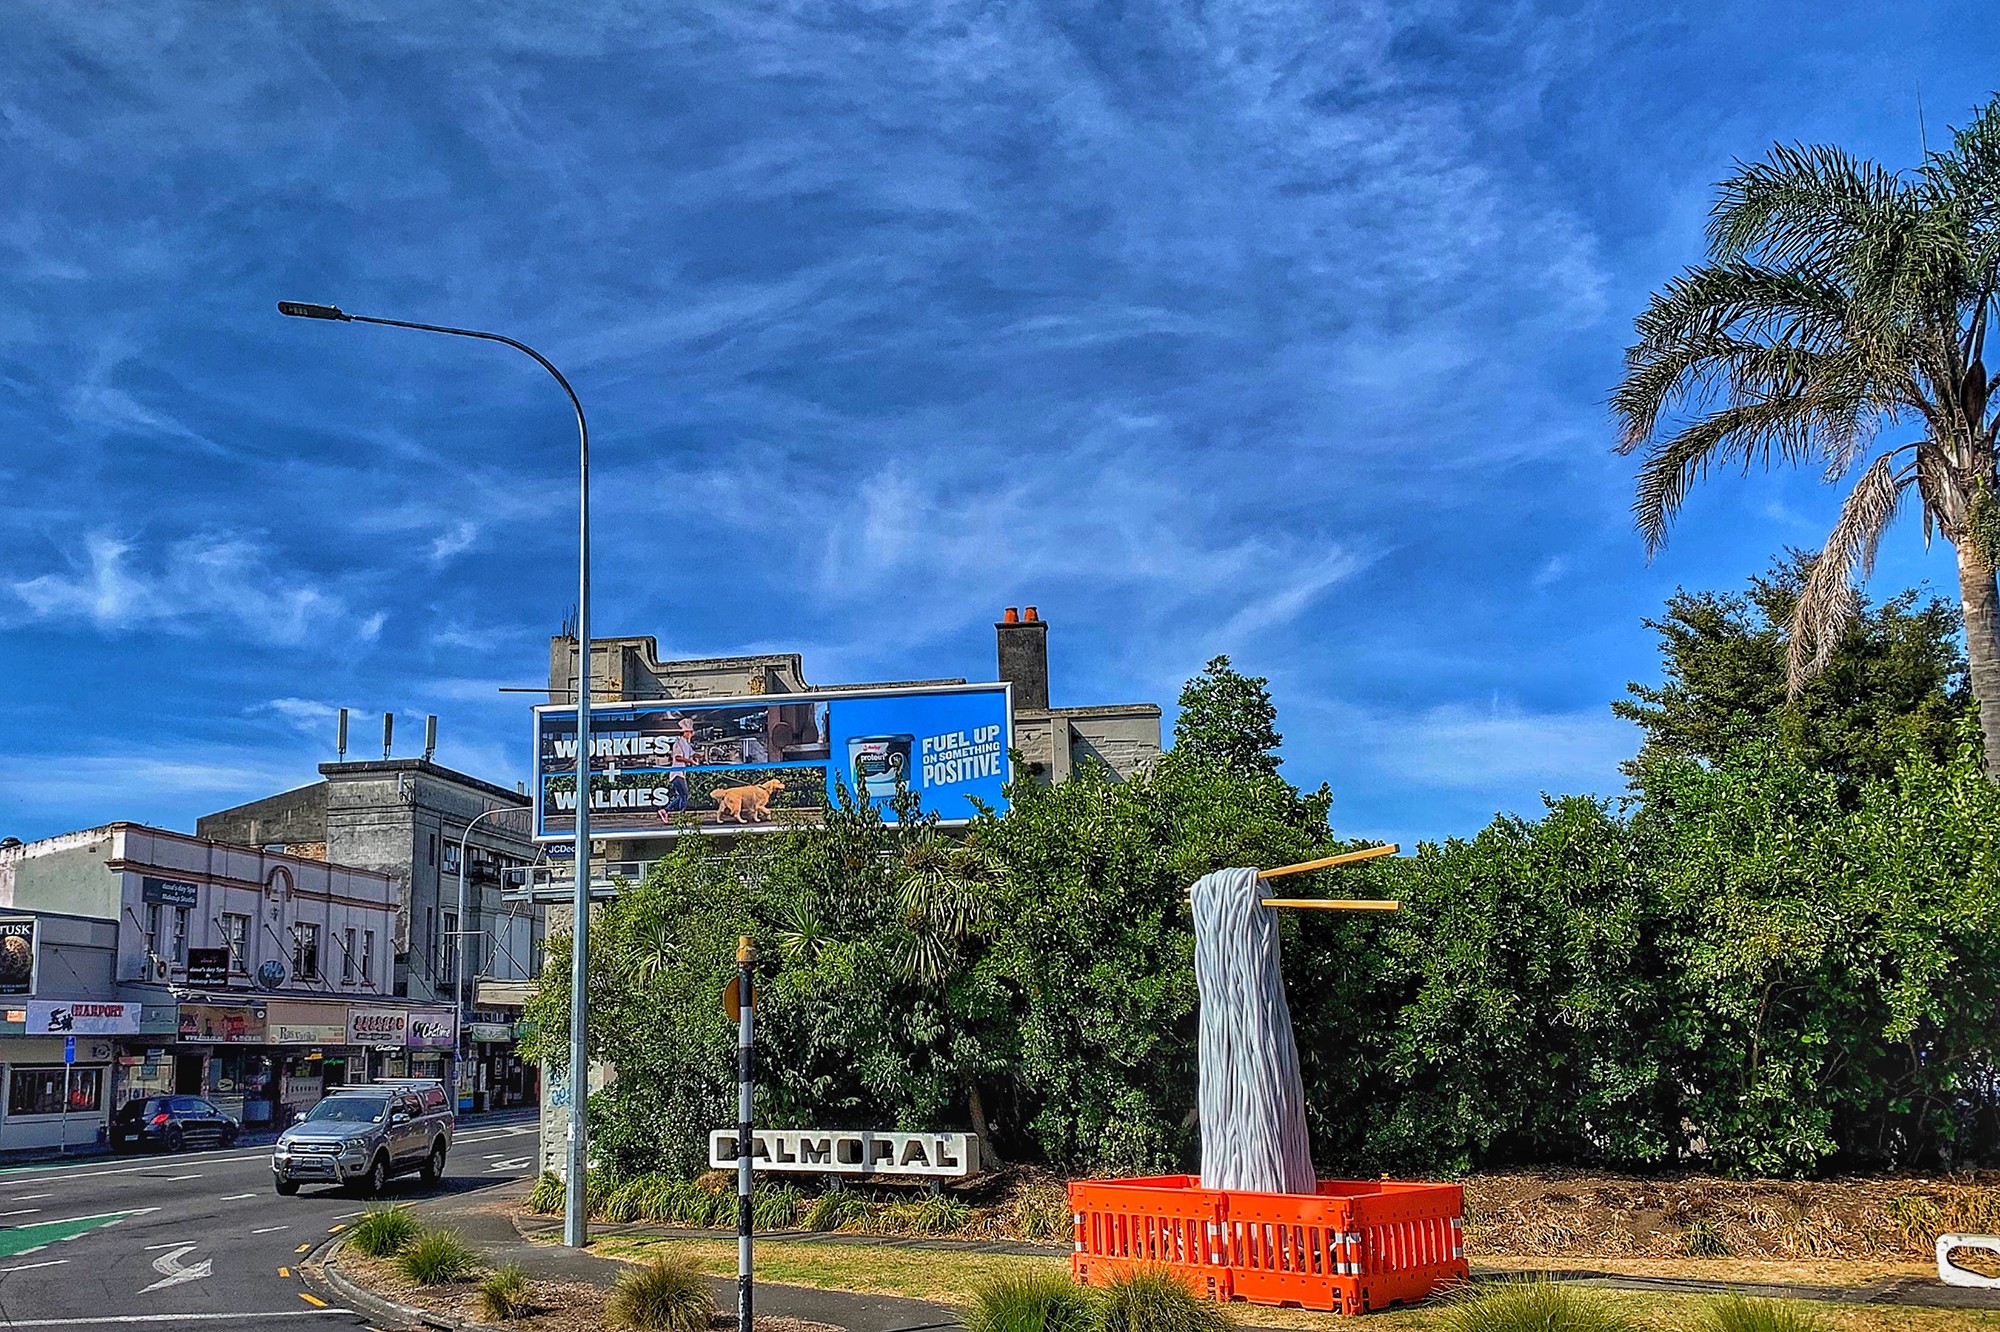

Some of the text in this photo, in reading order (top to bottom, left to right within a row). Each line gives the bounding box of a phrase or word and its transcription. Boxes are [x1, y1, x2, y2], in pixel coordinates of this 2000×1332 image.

[922, 724, 1000, 754] FUEL UP
[922, 742, 1000, 764] ON SOMETHING
[923, 751, 1001, 788] POSITIVE
[554, 787, 669, 810] WLKIES
[549, 845, 576, 853] JCDec
[422, 1021, 451, 1039] Chatime
